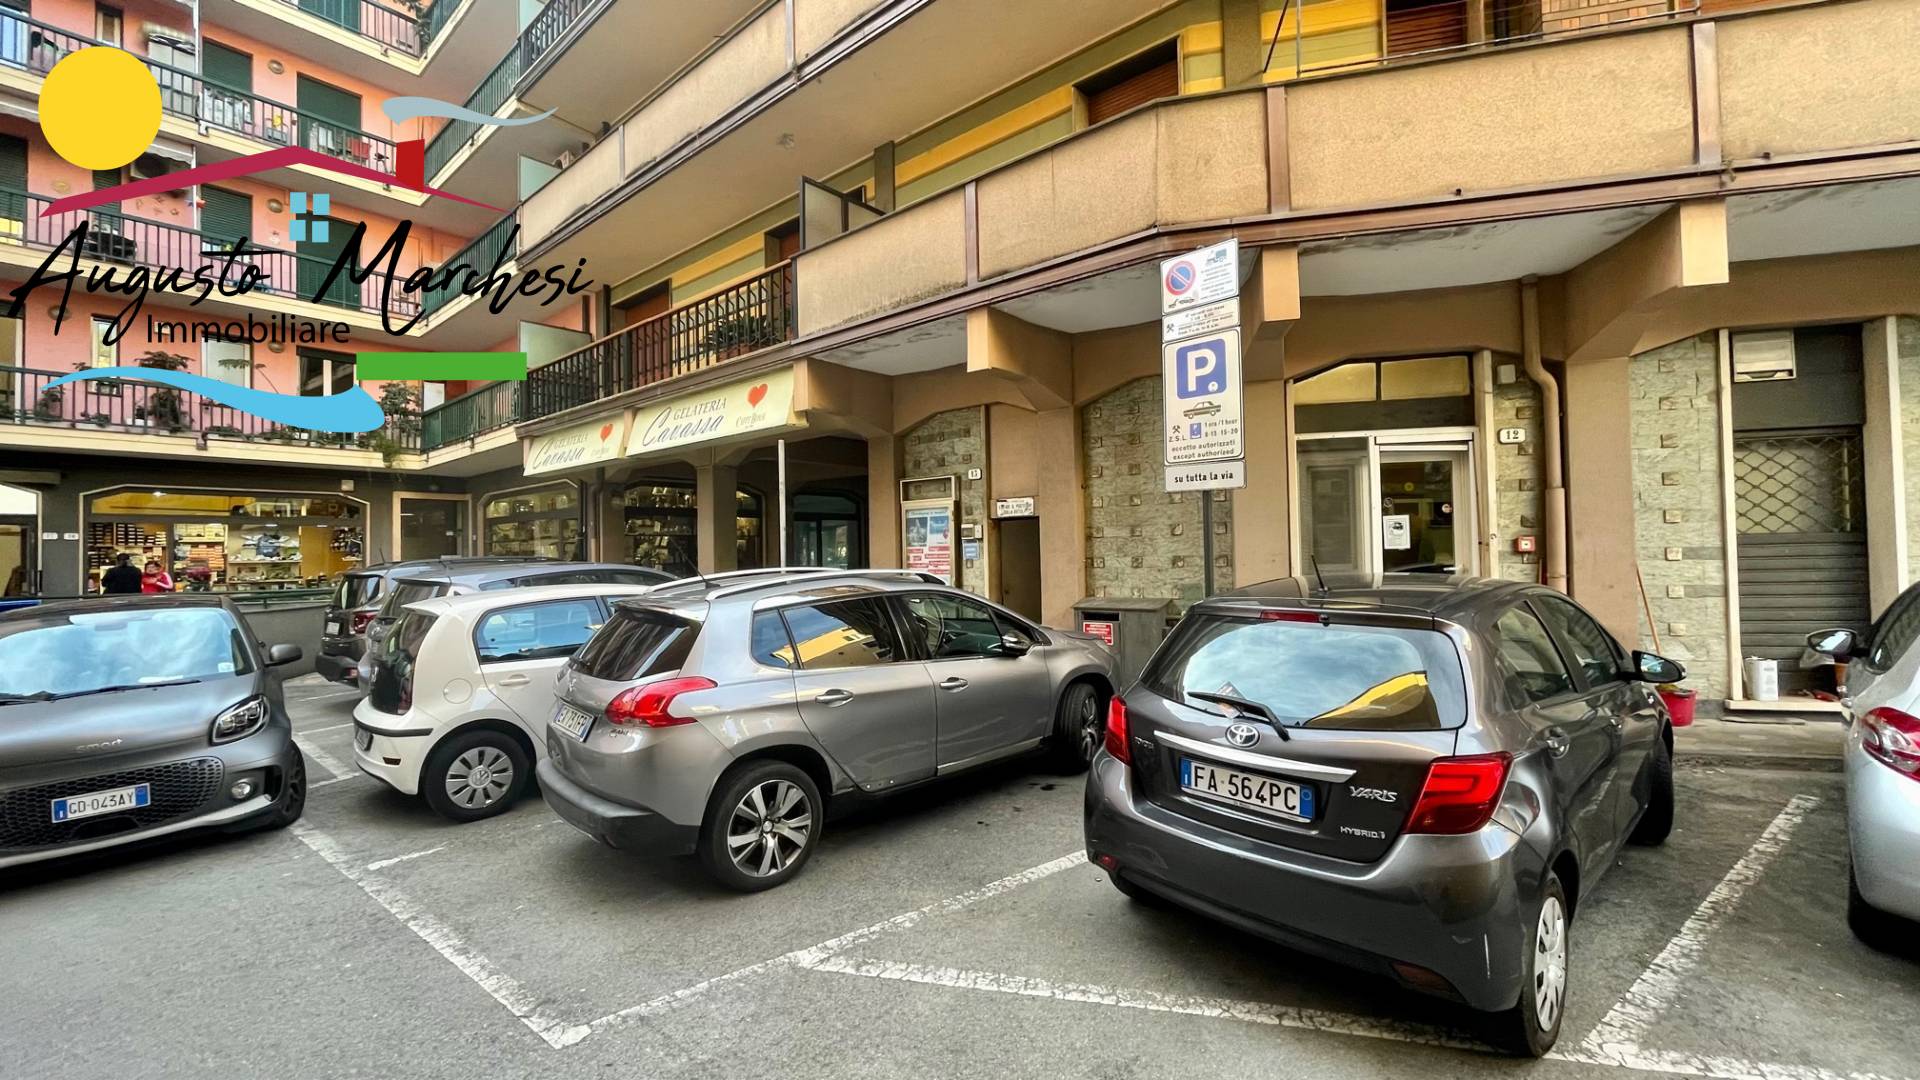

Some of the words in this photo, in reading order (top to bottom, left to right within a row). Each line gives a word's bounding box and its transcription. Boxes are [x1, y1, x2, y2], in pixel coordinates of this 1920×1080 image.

[1187, 348, 1216, 392] P
[673, 398, 727, 420] GELATERIA
[1506, 430, 1520, 440] 12
[1171, 444, 1197, 452] eccetto
[1198, 440, 1236, 449] autorizzati
[1173, 453, 1196, 461] except
[1197, 448, 1235, 458] authorized
[1186, 473, 1207, 482] tutta
[1209, 472, 1218, 481] la
[1221, 470, 1234, 479] via
[1349, 785, 1398, 803] YARIS
